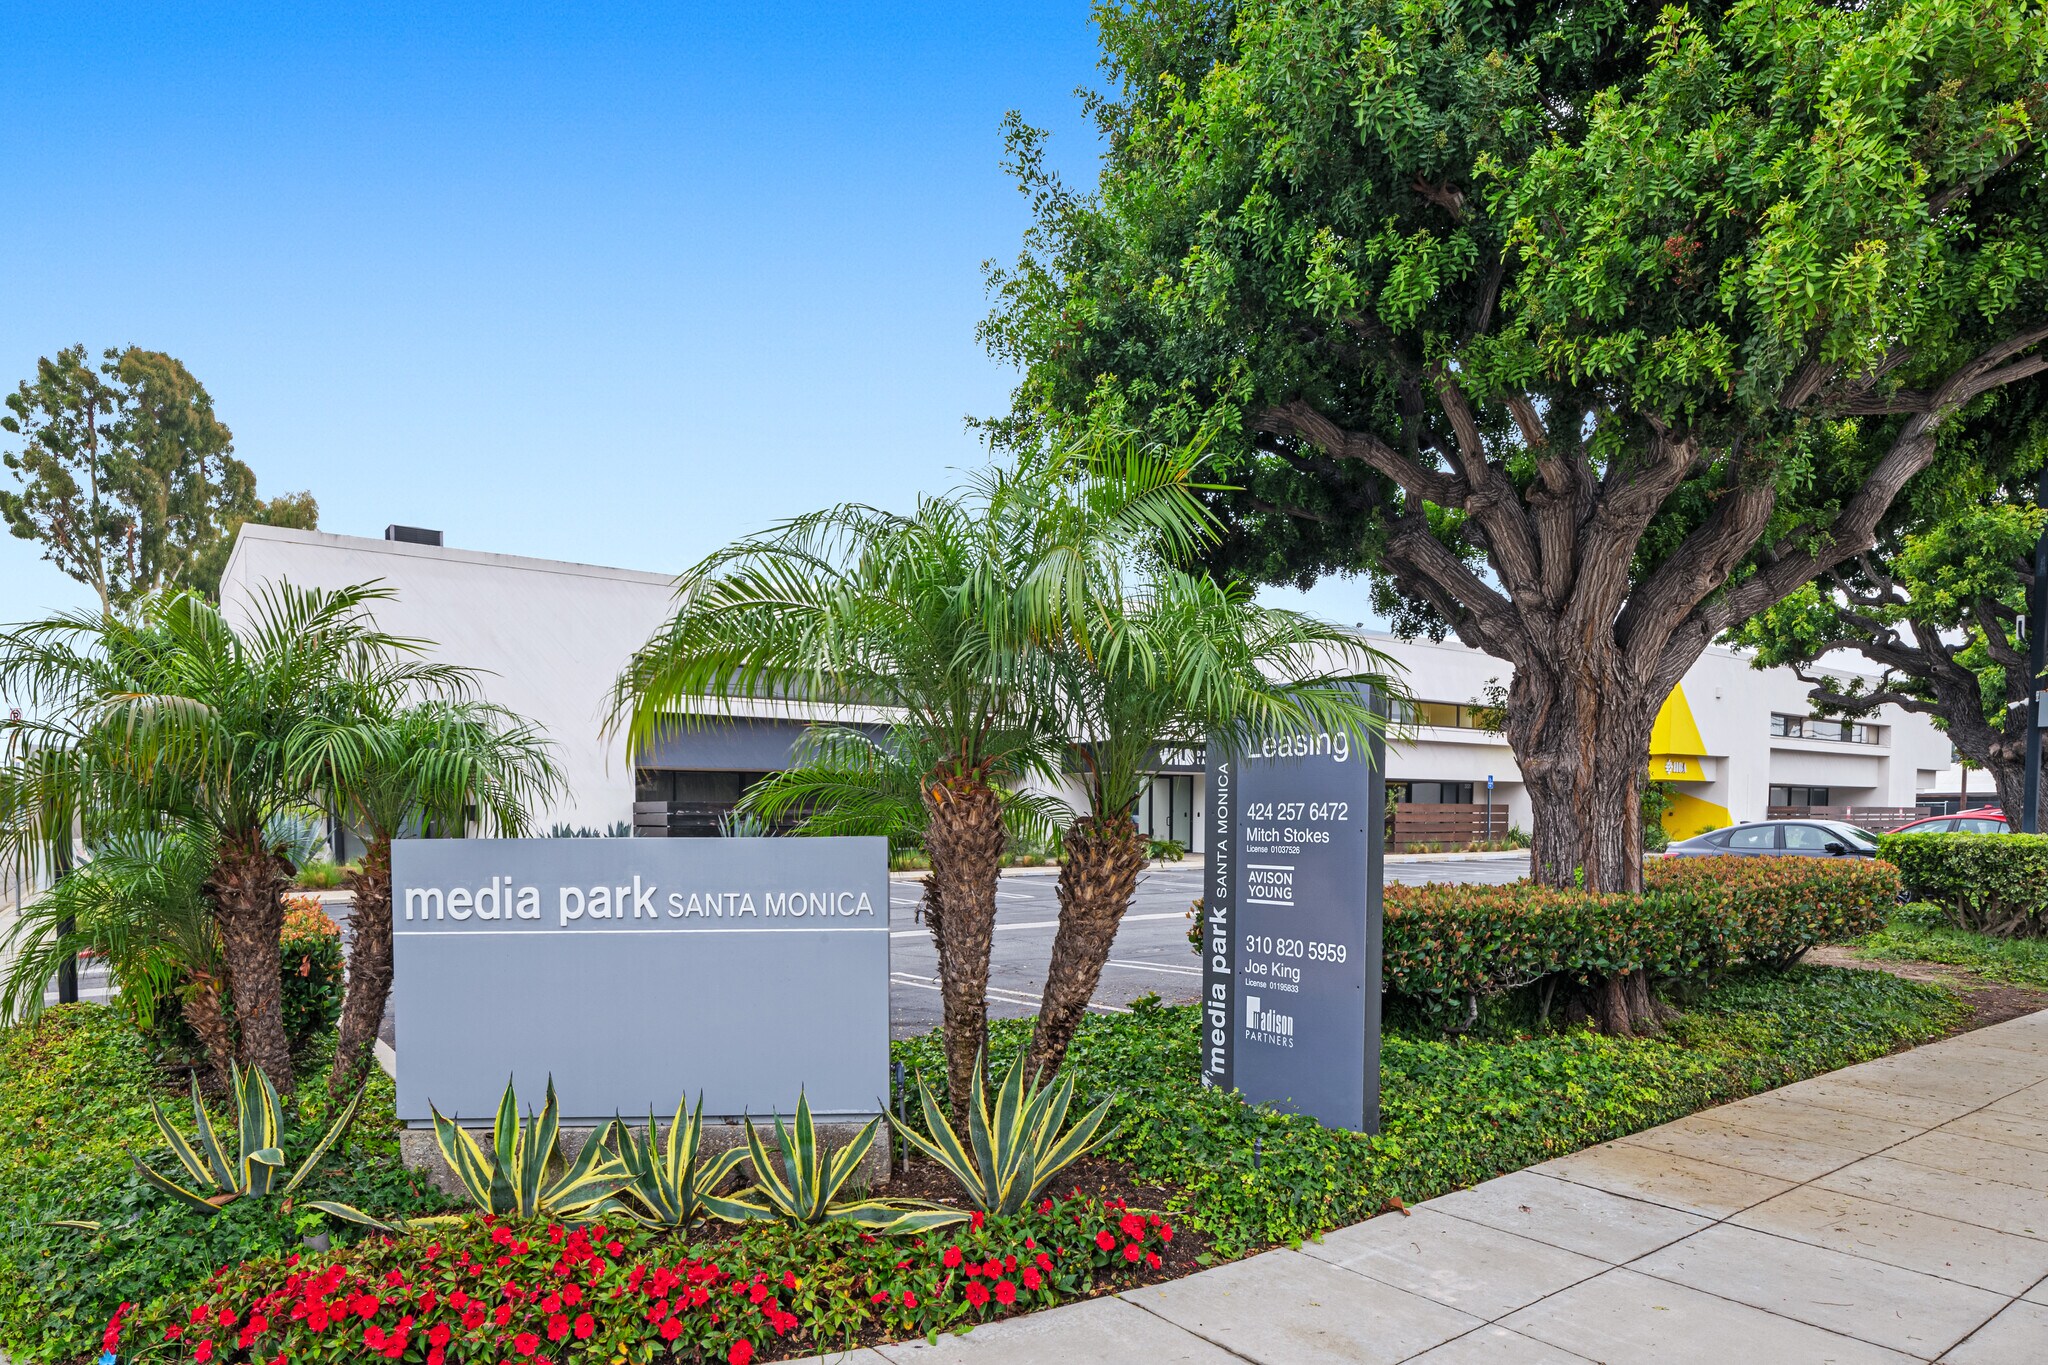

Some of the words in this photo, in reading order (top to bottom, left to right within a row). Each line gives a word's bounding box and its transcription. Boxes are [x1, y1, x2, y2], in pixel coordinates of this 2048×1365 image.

[1248, 731, 1349, 762] Leasing
[1217, 762, 1229, 834] MONICA
[1247, 802, 1273, 821] 424
[1277, 802, 1305, 821] 257
[1309, 802, 1348, 821] 6472
[1246, 827, 1280, 842] Mitch
[1283, 827, 1330, 844] Stokes
[1246, 844, 1269, 853] License
[1270, 845, 1301, 854] 01037526
[1216, 839, 1228, 899] SANTA
[1248, 871, 1293, 885] AVISON
[405, 876, 541, 921] media
[559, 875, 658, 927] park
[667, 892, 758, 918] SANTA
[765, 891, 875, 917] MONICA
[1248, 884, 1293, 900] YOUNG
[1208, 906, 1231, 975] park
[1245, 934, 1272, 954] 310
[1276, 938, 1304, 958] 820
[1307, 941, 1347, 964] 5959
[1244, 958, 1268, 975] Joe
[1271, 961, 1301, 984] King
[1245, 977, 1267, 989] License
[1207, 983, 1226, 1074] media
[1245, 1029, 1294, 1048] PARTNERS
